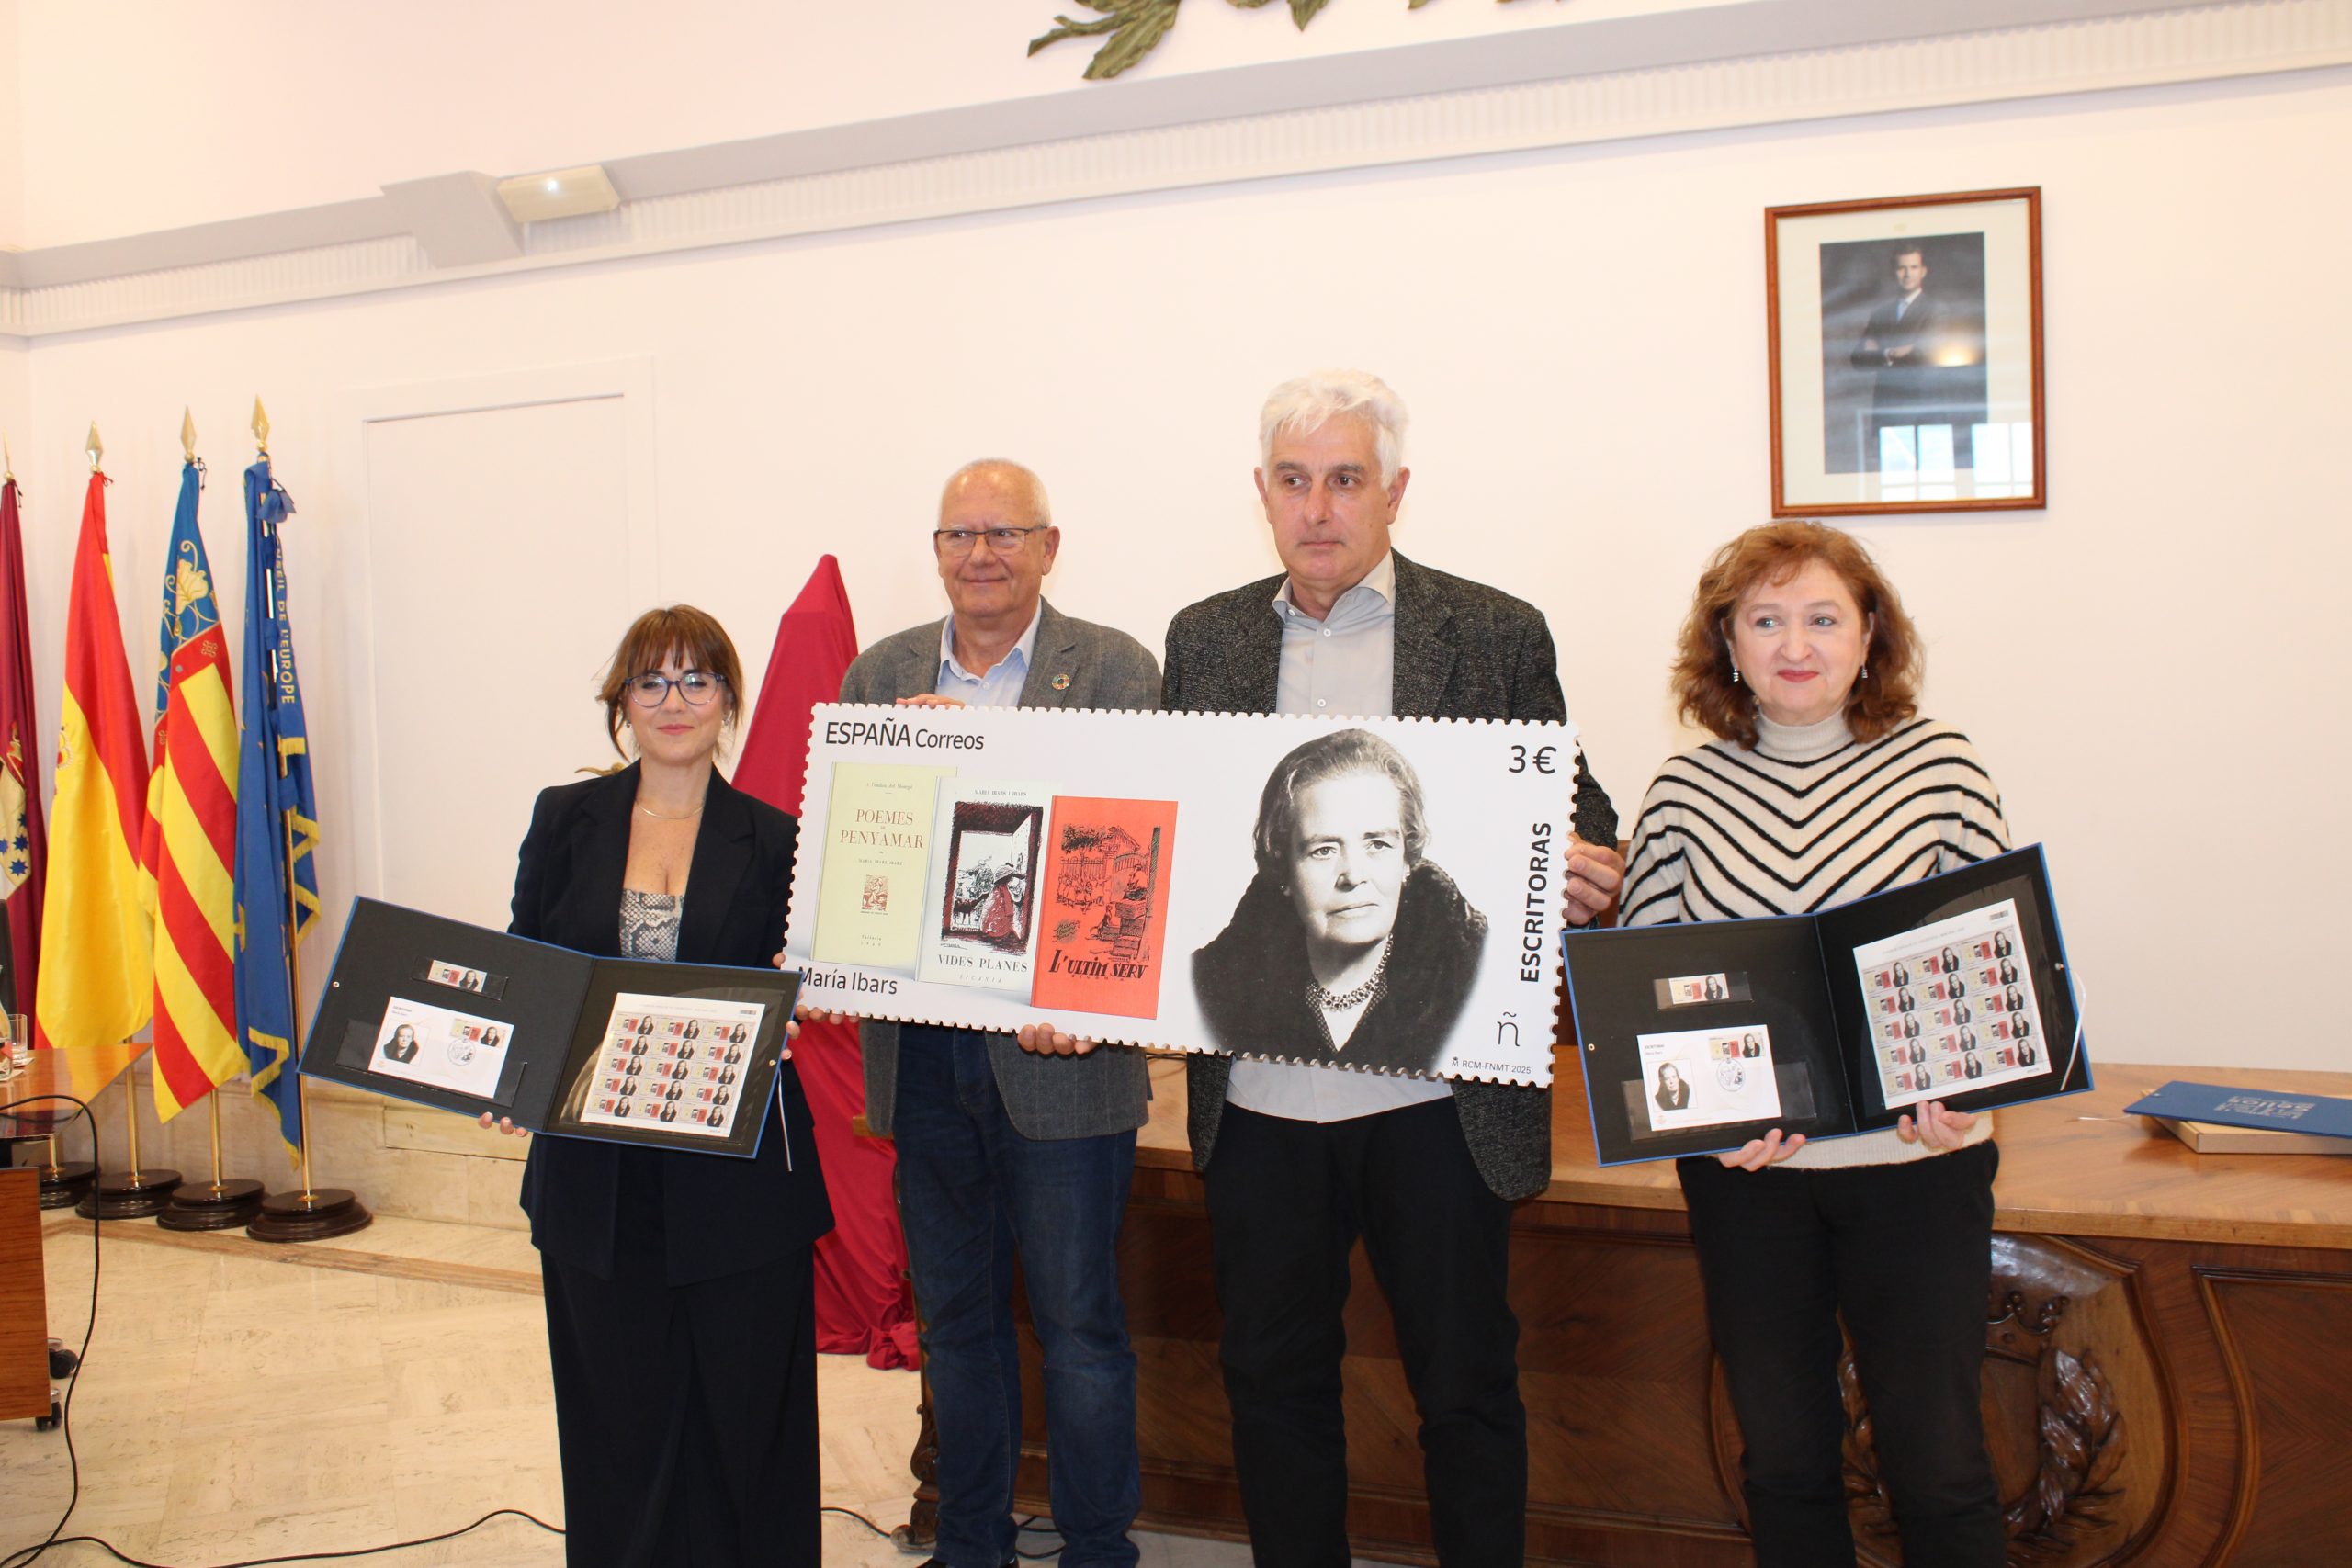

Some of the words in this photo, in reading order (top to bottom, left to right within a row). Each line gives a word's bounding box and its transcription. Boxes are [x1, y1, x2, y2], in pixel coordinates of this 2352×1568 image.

[277, 600, 288, 622] DE
[279, 628, 295, 704] L'EUROPE
[825, 717, 910, 747] ESPAÑA
[915, 728, 985, 750] Correos
[855, 808, 914, 826] POEMES
[840, 829, 924, 849] PENYAMAR
[1520, 822, 1552, 983] ESCRITORAS
[938, 954, 974, 968] VIDES
[979, 958, 1028, 973] PLANES
[1110, 963, 1149, 980] SERV
[797, 966, 846, 989] María
[852, 972, 898, 995] Ibars
[1497, 1011, 1521, 1047] ñ
[1462, 1059, 1510, 1073] RCM-FNMT
[1511, 1065, 1532, 1075] 2025
